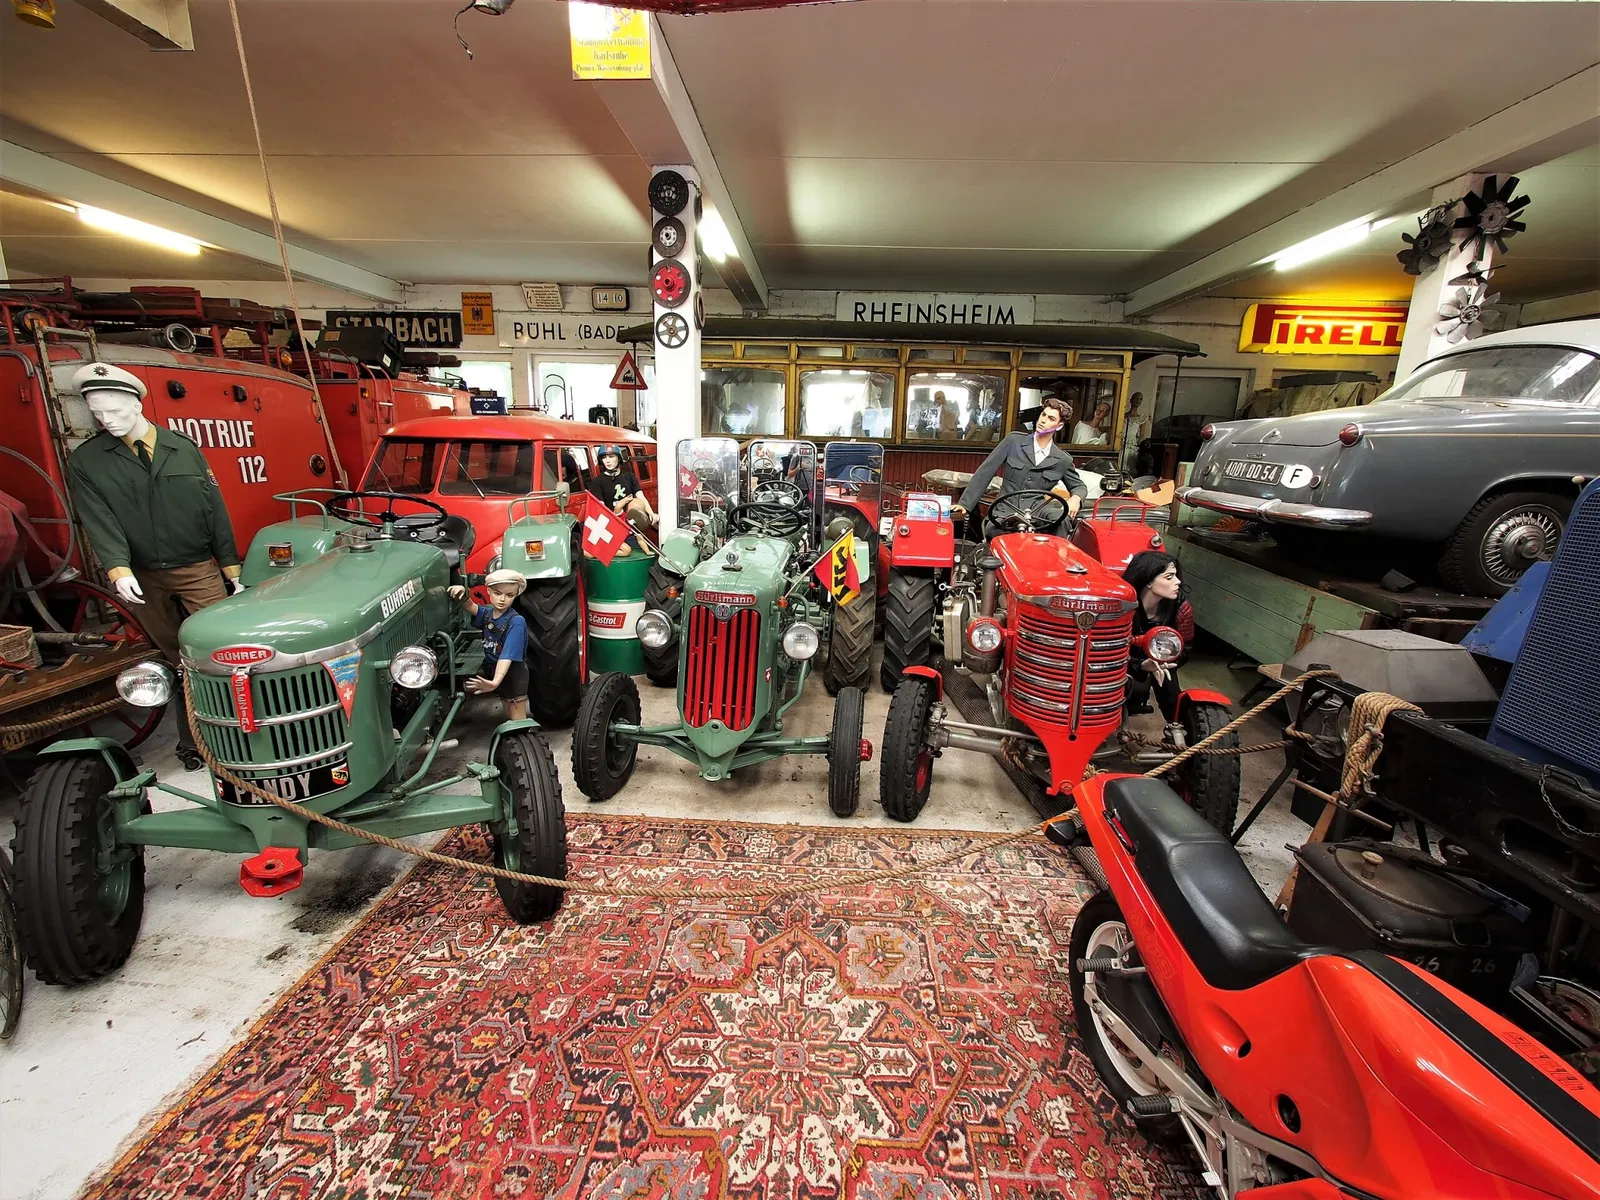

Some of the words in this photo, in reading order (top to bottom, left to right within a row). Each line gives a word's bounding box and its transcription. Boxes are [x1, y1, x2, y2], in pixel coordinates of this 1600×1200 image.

[853, 301, 1016, 325] RHEINSHEIM
[513, 321, 566, 341] BÜHL
[1251, 303, 1409, 347] PIRELL
[237, 455, 268, 484] 112
[1289, 468, 1304, 484] F
[380, 579, 415, 619] BÜHRER
[697, 591, 754, 604] Hürlimann
[1051, 597, 1120, 612] Hürlimann
[592, 615, 617, 625] Castrol
[216, 650, 267, 661] BÜHRER
